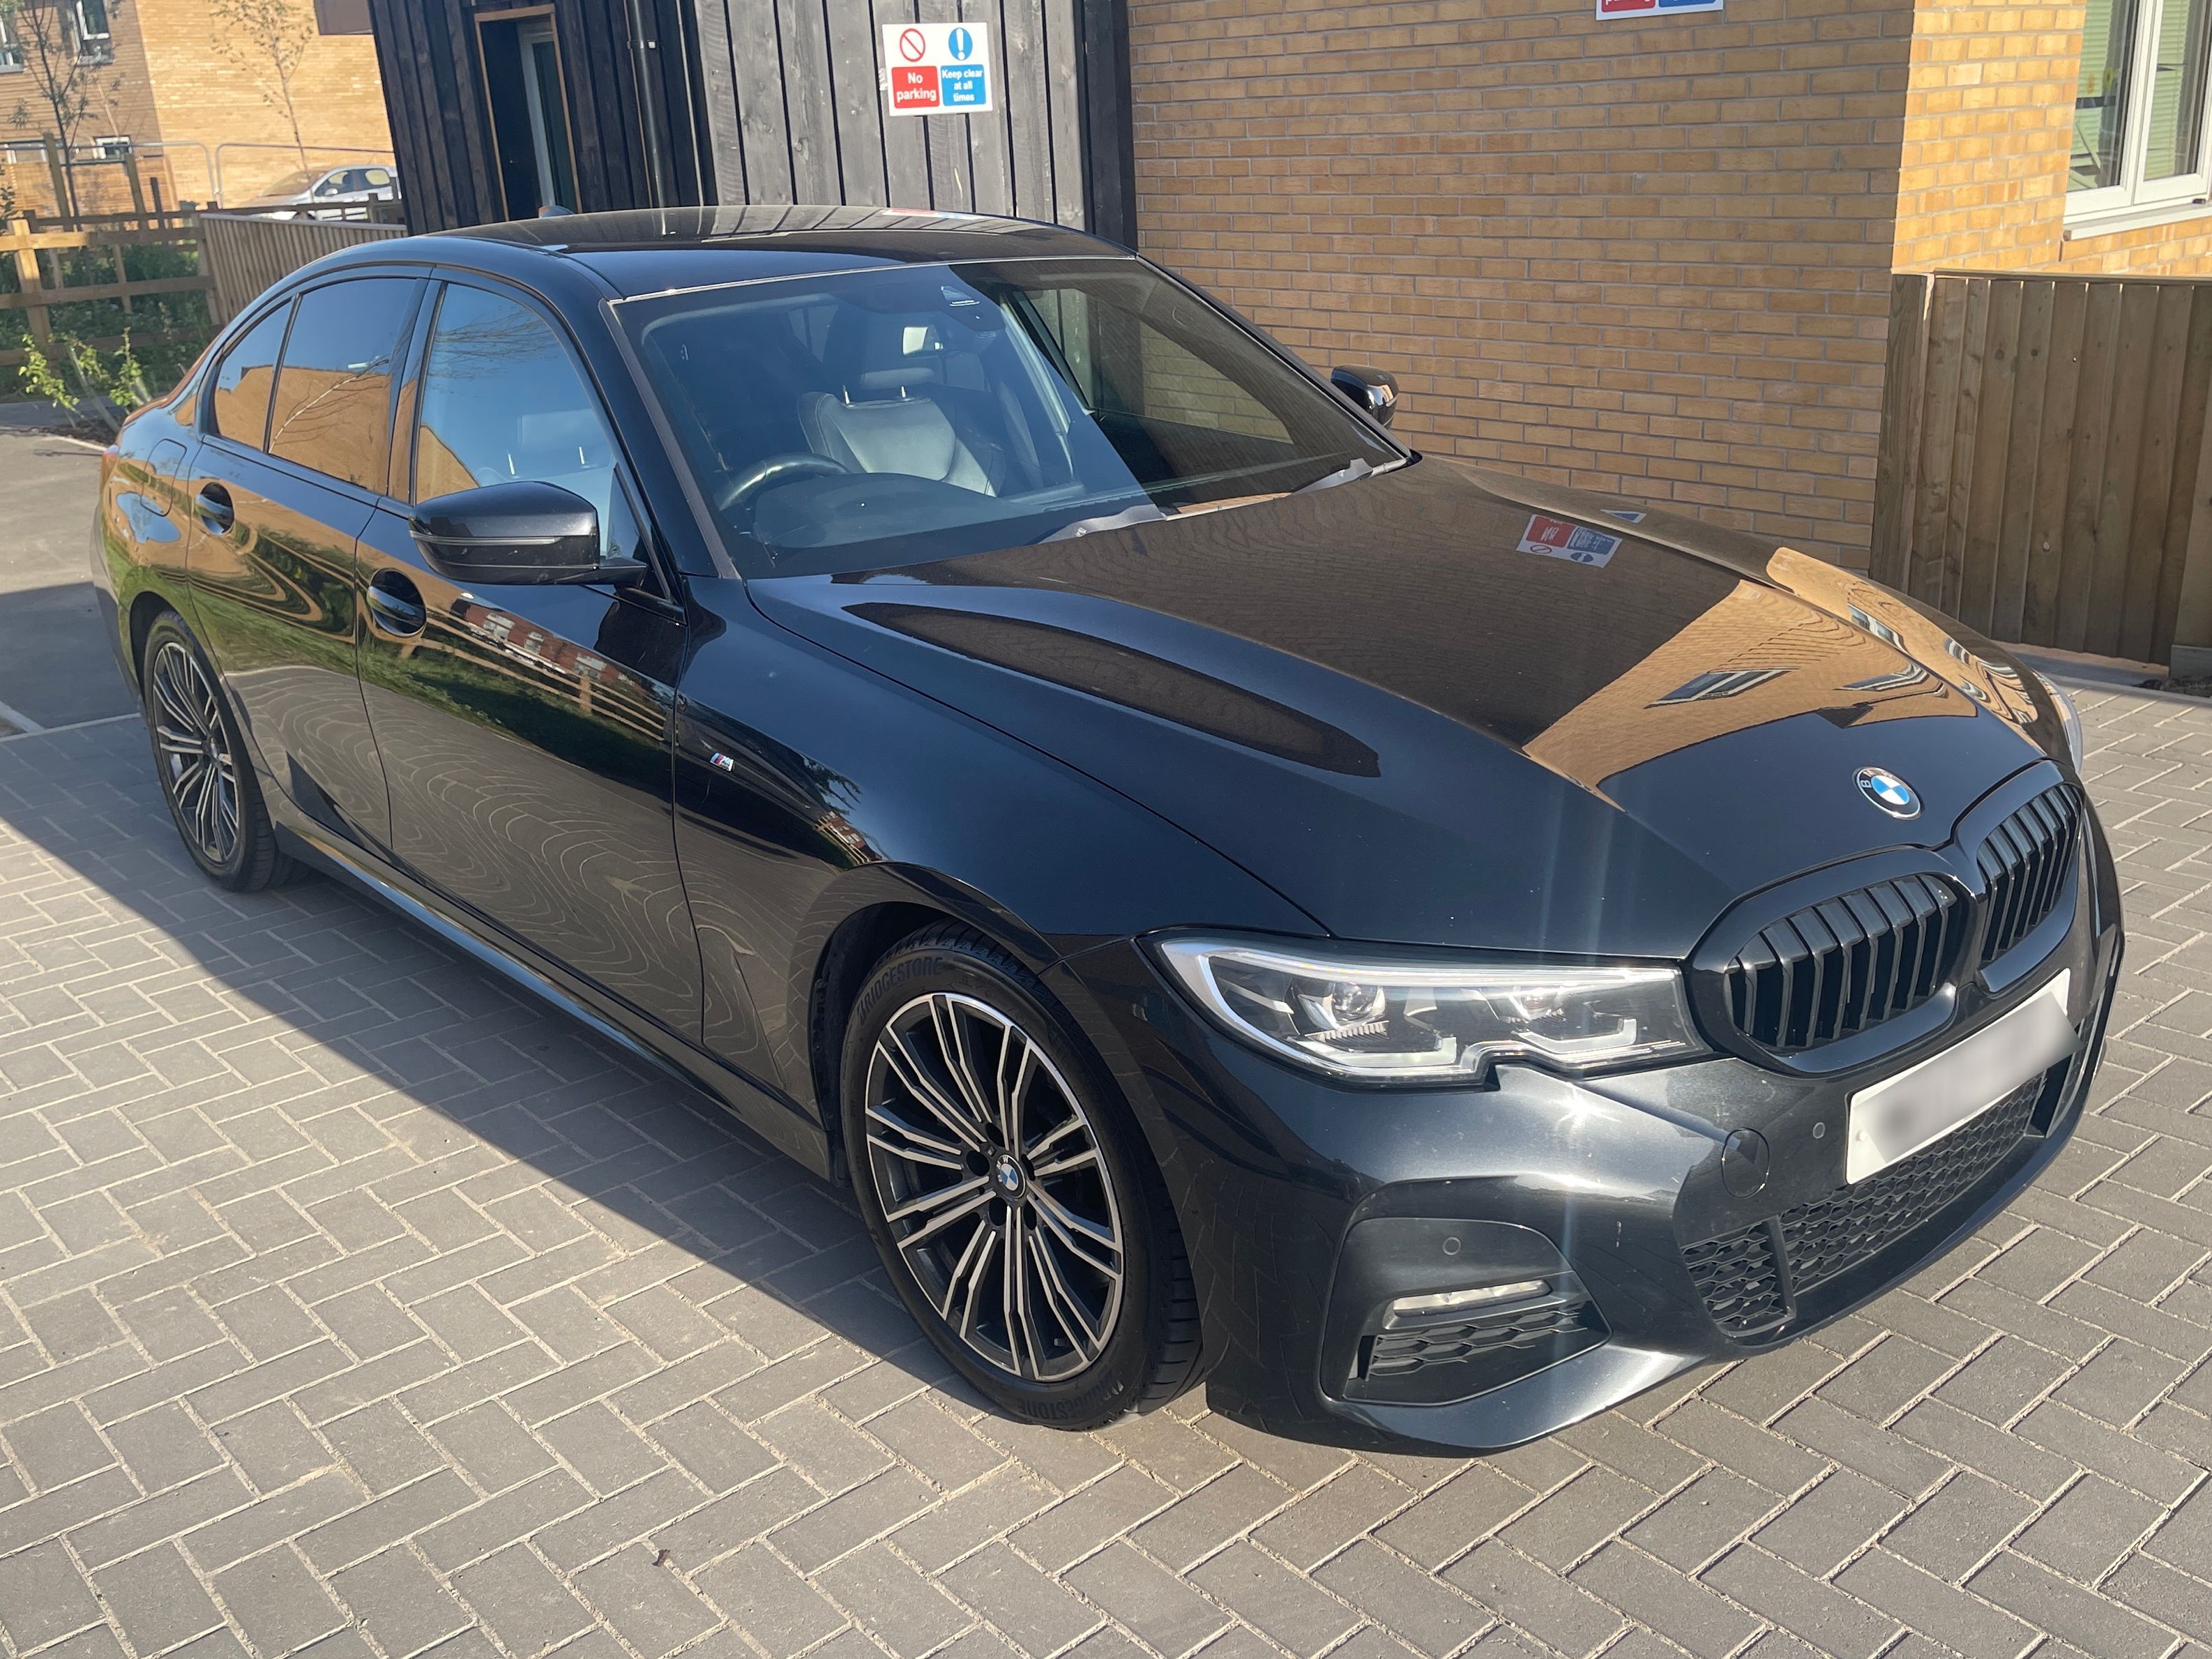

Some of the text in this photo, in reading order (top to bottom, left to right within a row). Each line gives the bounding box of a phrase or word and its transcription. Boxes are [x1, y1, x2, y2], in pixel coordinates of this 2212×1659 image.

[907, 72, 923, 84] No
[942, 69, 983, 80] Keep clear
[963, 81, 973, 90] all
[896, 89, 937, 103] parking
[953, 93, 975, 102] times
[856, 956, 944, 1026] BRIDGESTONE
